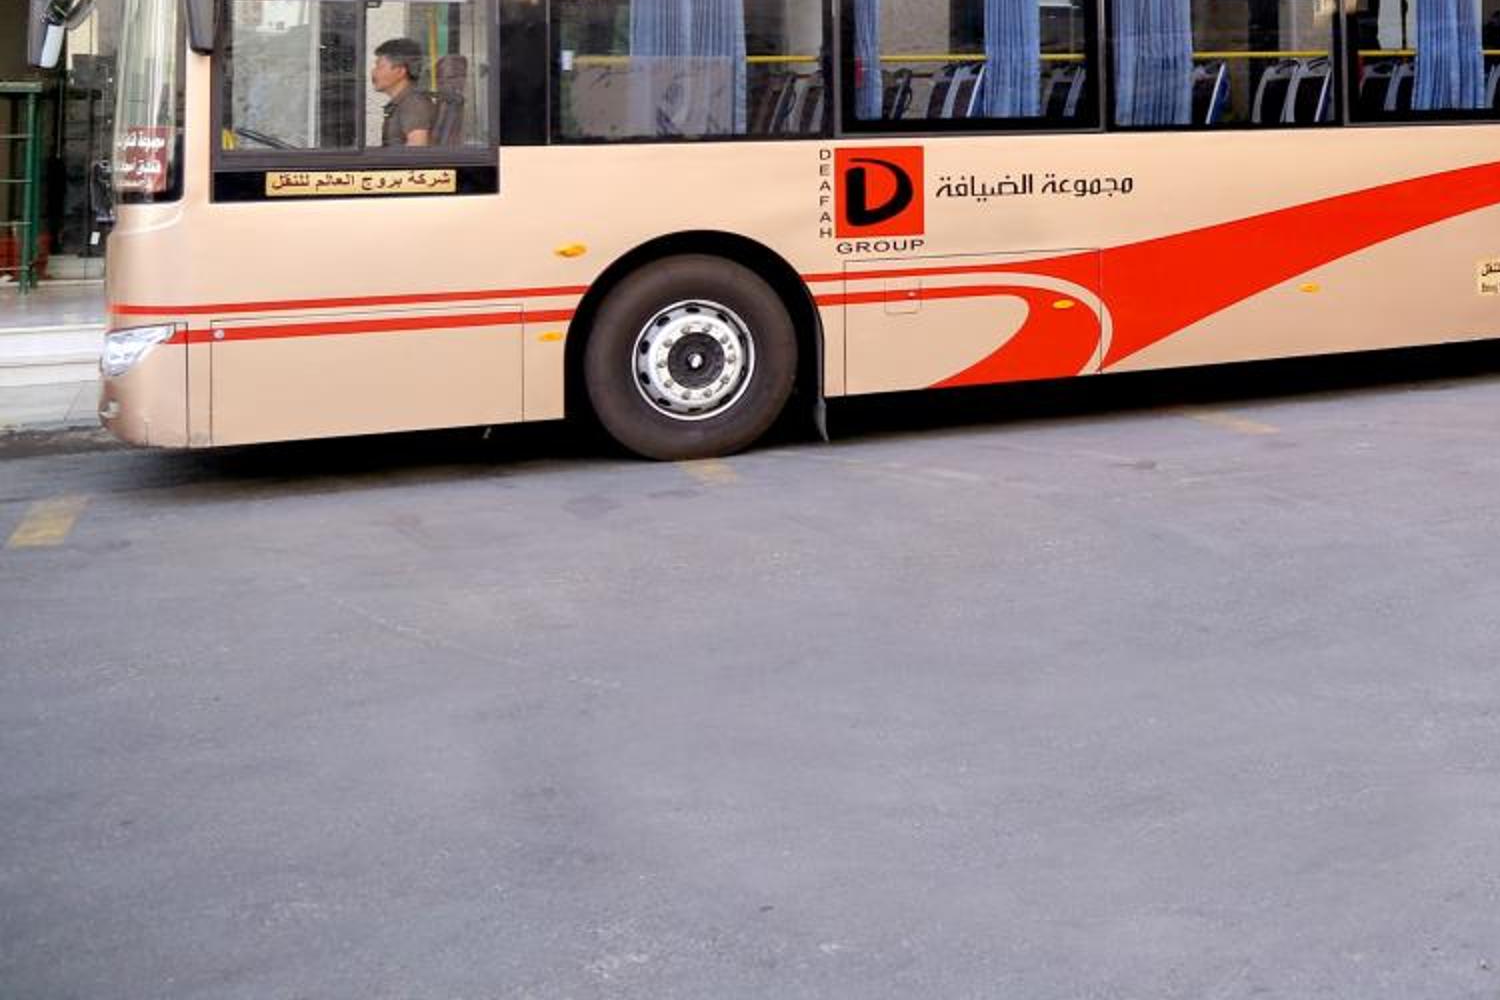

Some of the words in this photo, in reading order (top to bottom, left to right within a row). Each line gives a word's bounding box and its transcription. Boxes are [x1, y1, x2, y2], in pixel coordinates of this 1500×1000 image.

[315, 174, 355, 191] العالم
[361, 175, 403, 190] بروج
[408, 170, 451, 185] شركة
[1041, 173, 1134, 197] مجموعة
[819, 149, 832, 238] DEAFAH
[935, 174, 1033, 202] الضيافة
[836, 239, 925, 254] GROUP
